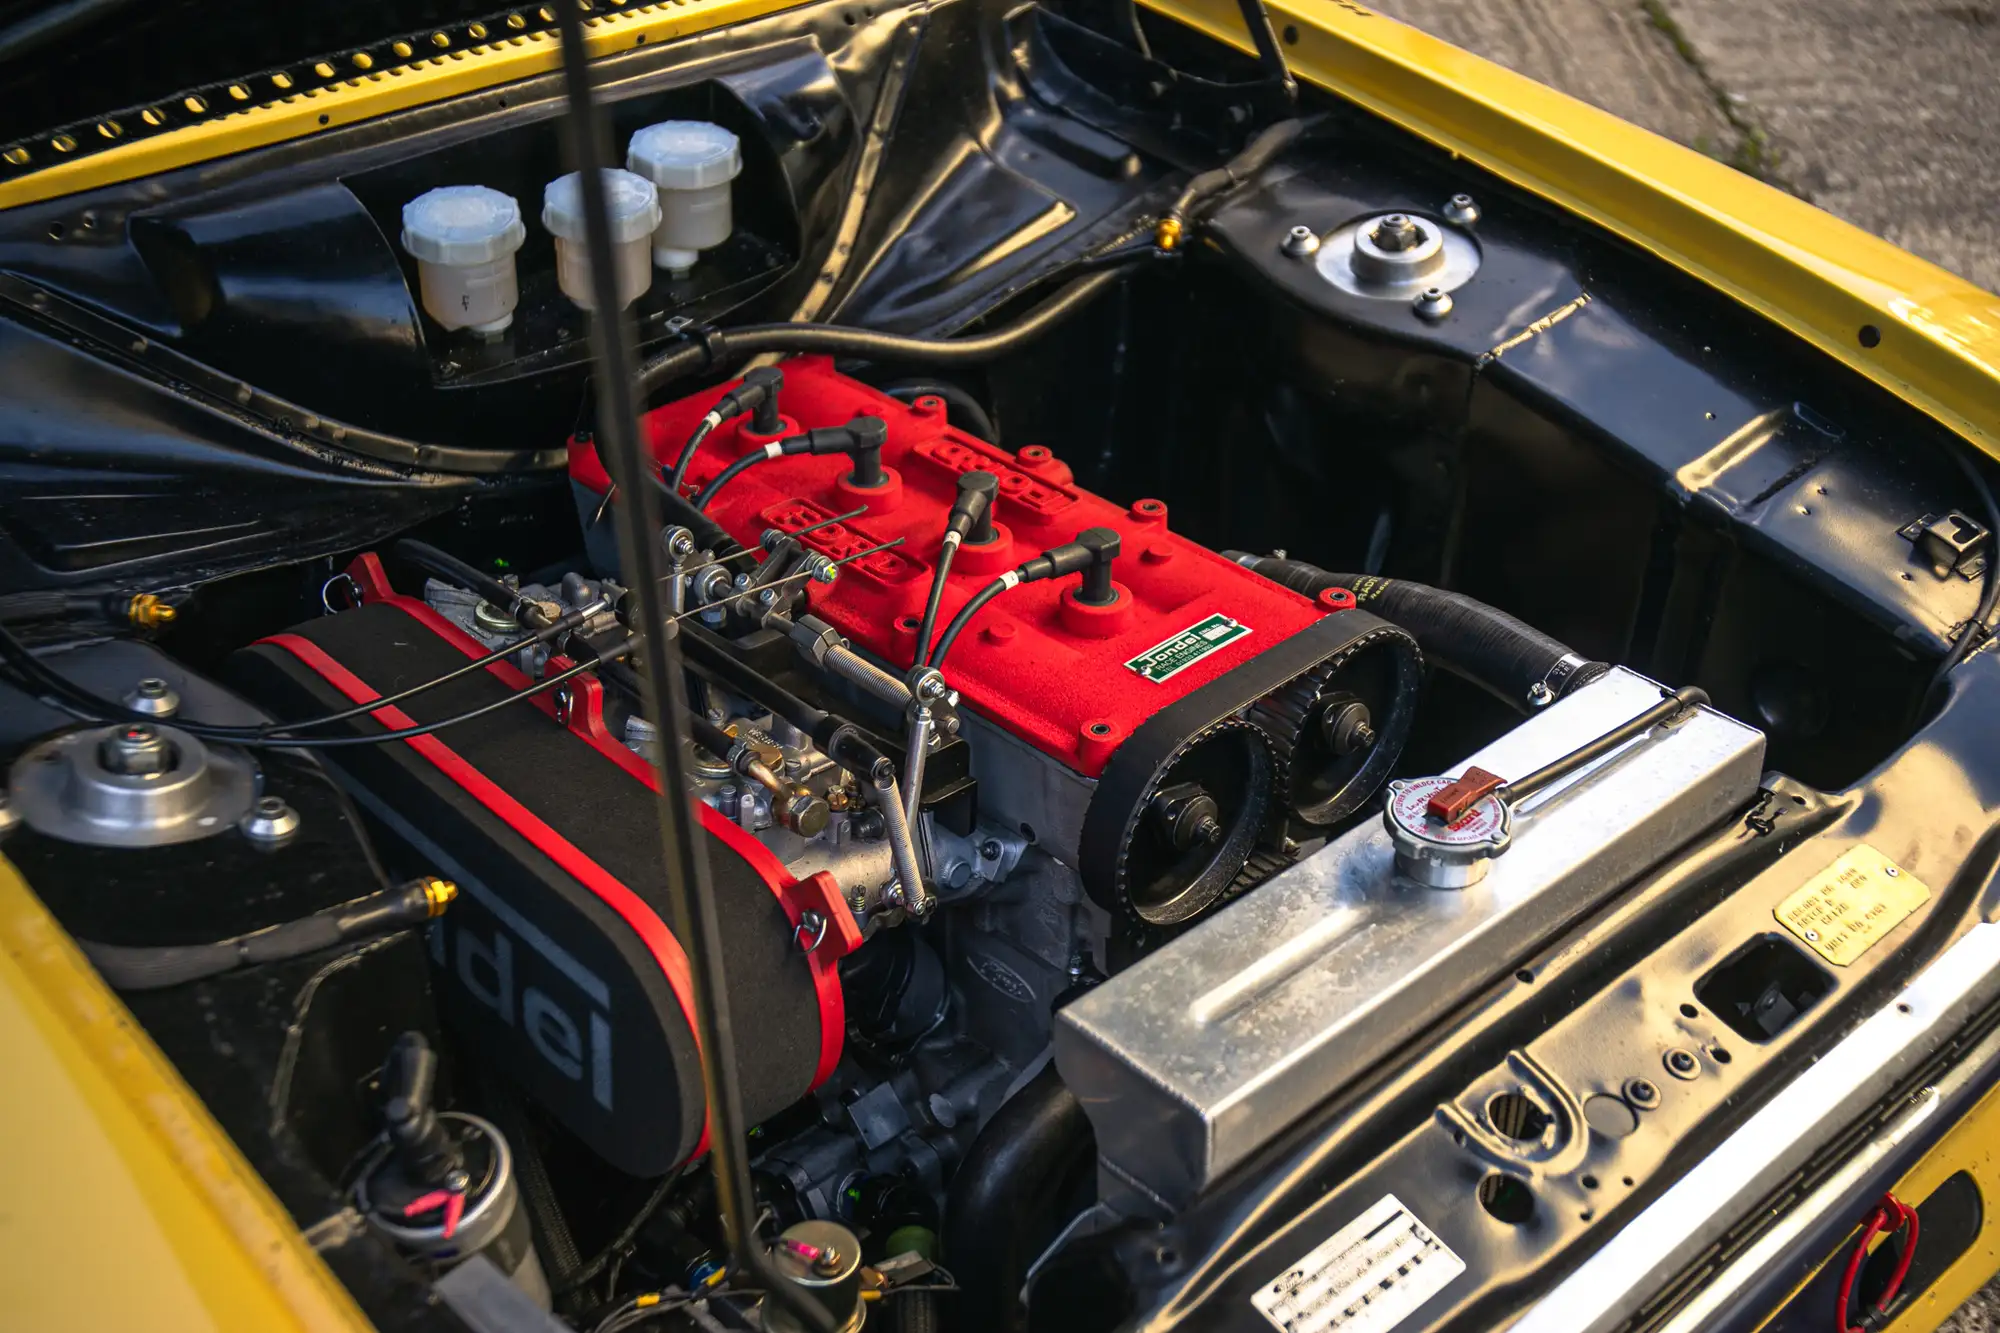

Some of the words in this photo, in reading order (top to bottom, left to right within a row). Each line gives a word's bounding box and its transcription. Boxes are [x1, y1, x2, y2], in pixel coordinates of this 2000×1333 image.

[1138, 632, 1202, 668] Jondel
[1155, 656, 1178, 671] RACE
[1174, 640, 1209, 659] ENGINES
[1409, 780, 1435, 790] UNLOCK
